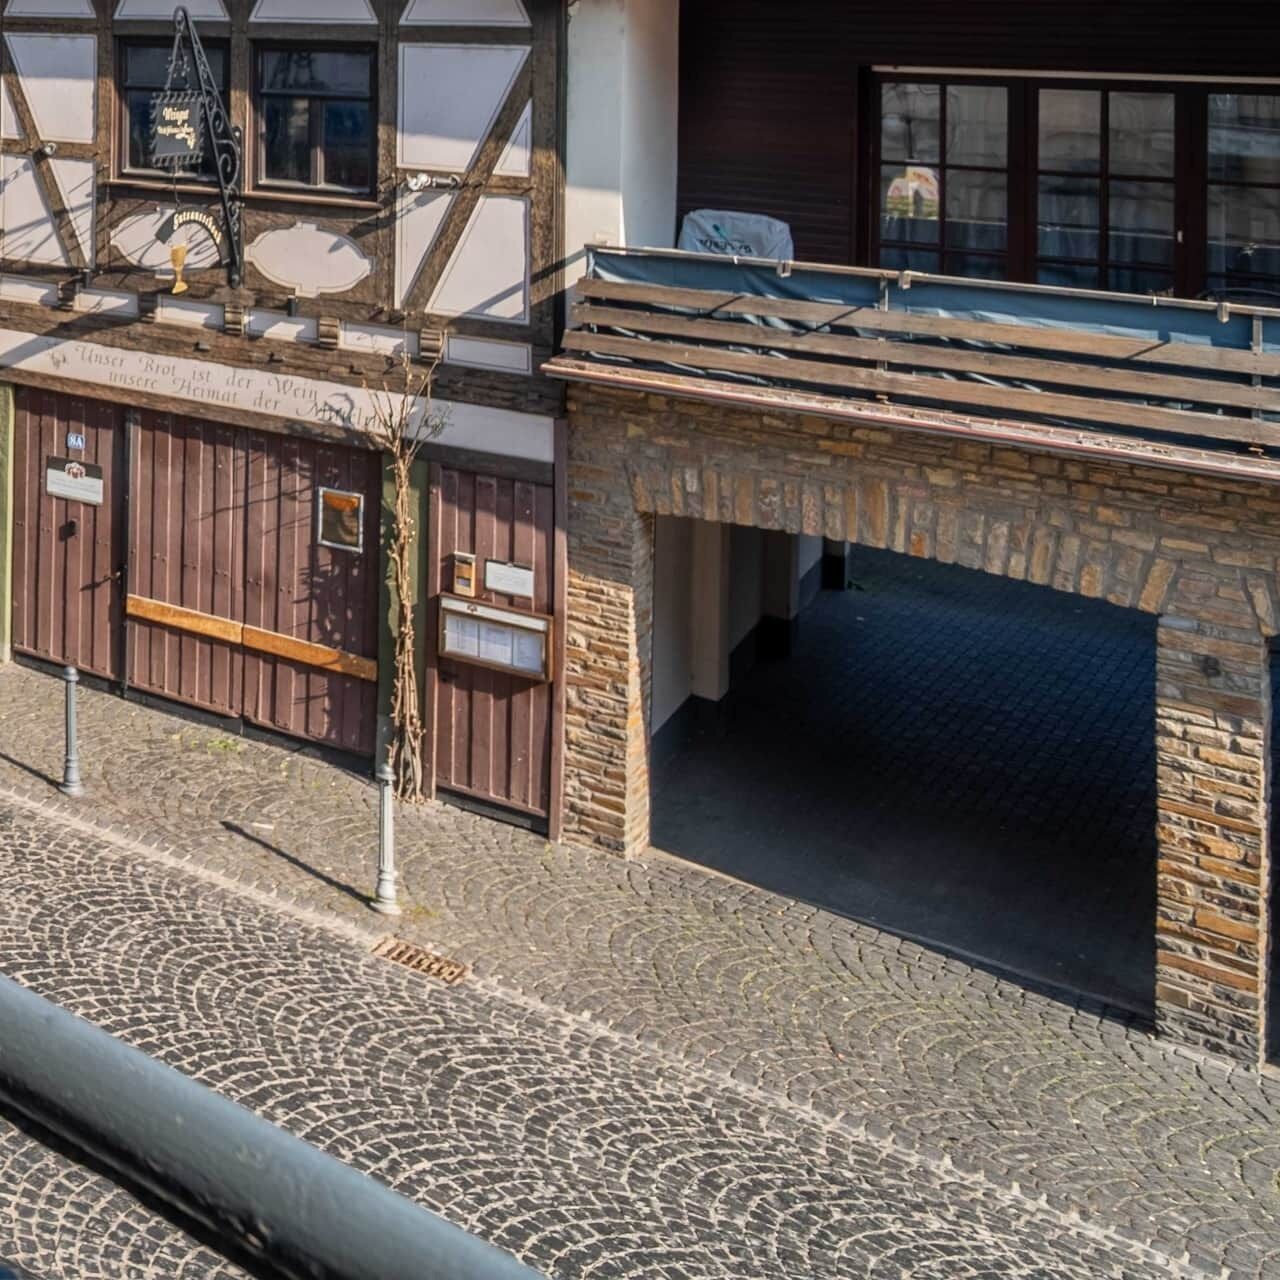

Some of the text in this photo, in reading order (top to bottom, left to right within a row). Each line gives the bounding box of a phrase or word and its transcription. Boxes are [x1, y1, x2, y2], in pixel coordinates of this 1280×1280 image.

[75, 345, 317, 401] Unser Brot ist der Wein
[108, 371, 158, 390] unsere
[170, 375, 238, 404] Heimat
[253, 388, 280, 410] der
